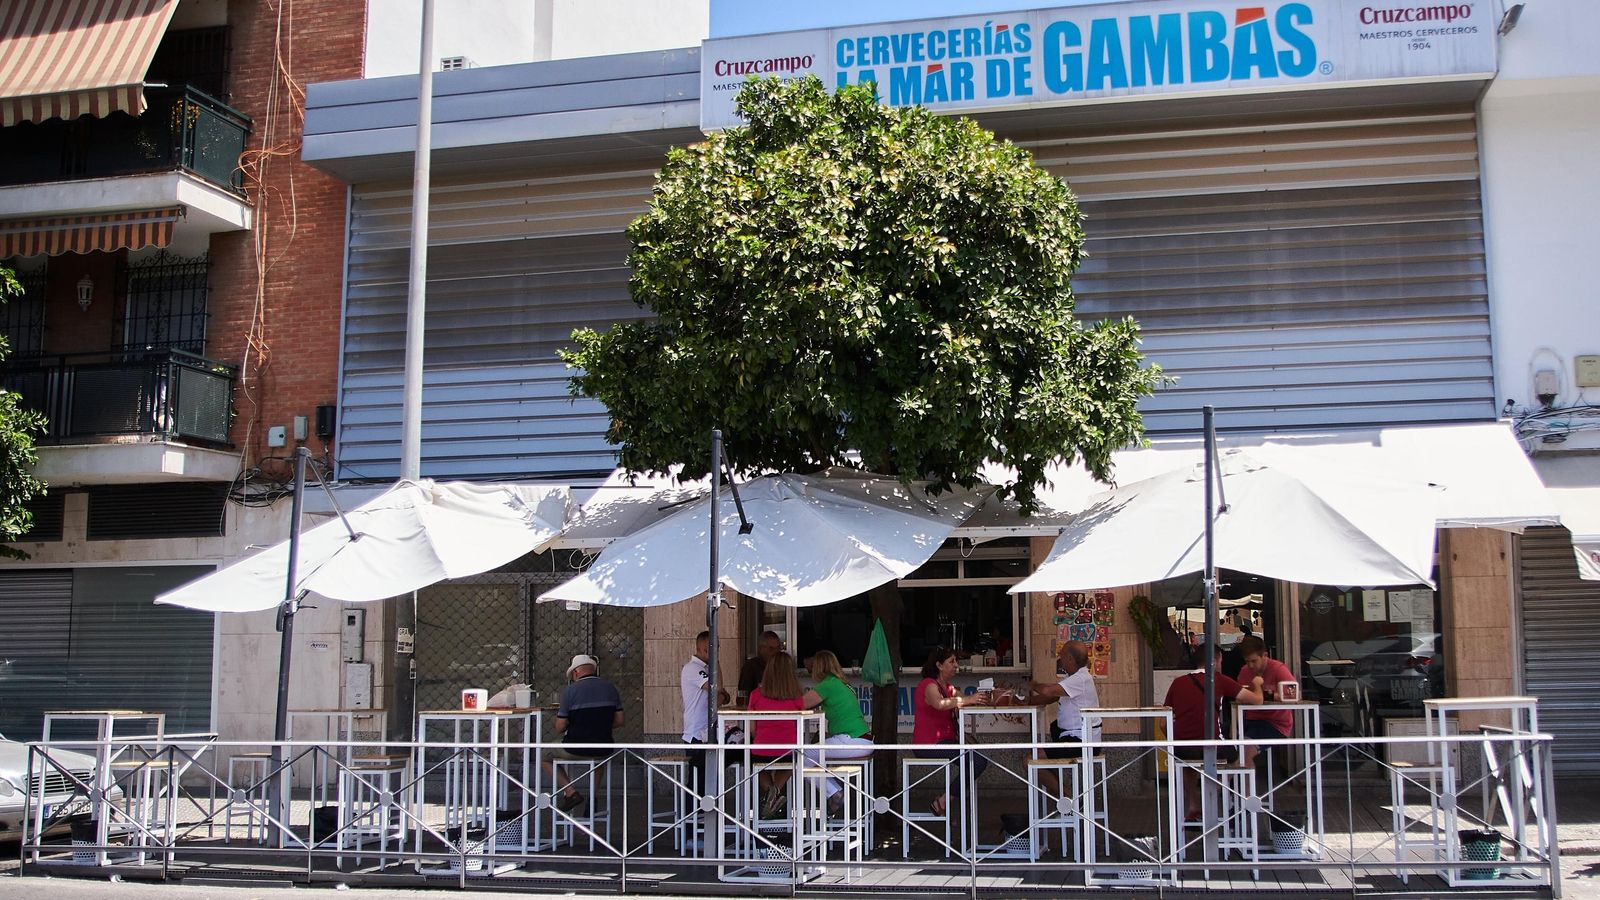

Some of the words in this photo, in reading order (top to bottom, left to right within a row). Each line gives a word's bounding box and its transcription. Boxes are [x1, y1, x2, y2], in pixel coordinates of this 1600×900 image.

[1360, 4, 1471, 24] Cruzcampo
[836, 20, 1032, 68] CERVECERÍAS
[1360, 30, 1413, 40] MAESTROS
[1416, 26, 1478, 37] CERVECEROS
[1043, 2, 1317, 94] GAMBAS
[1407, 42, 1431, 51] 1904
[715, 55, 813, 77] Cruzcampo
[889, 63, 975, 106] MAR
[986, 56, 1033, 98] DE
